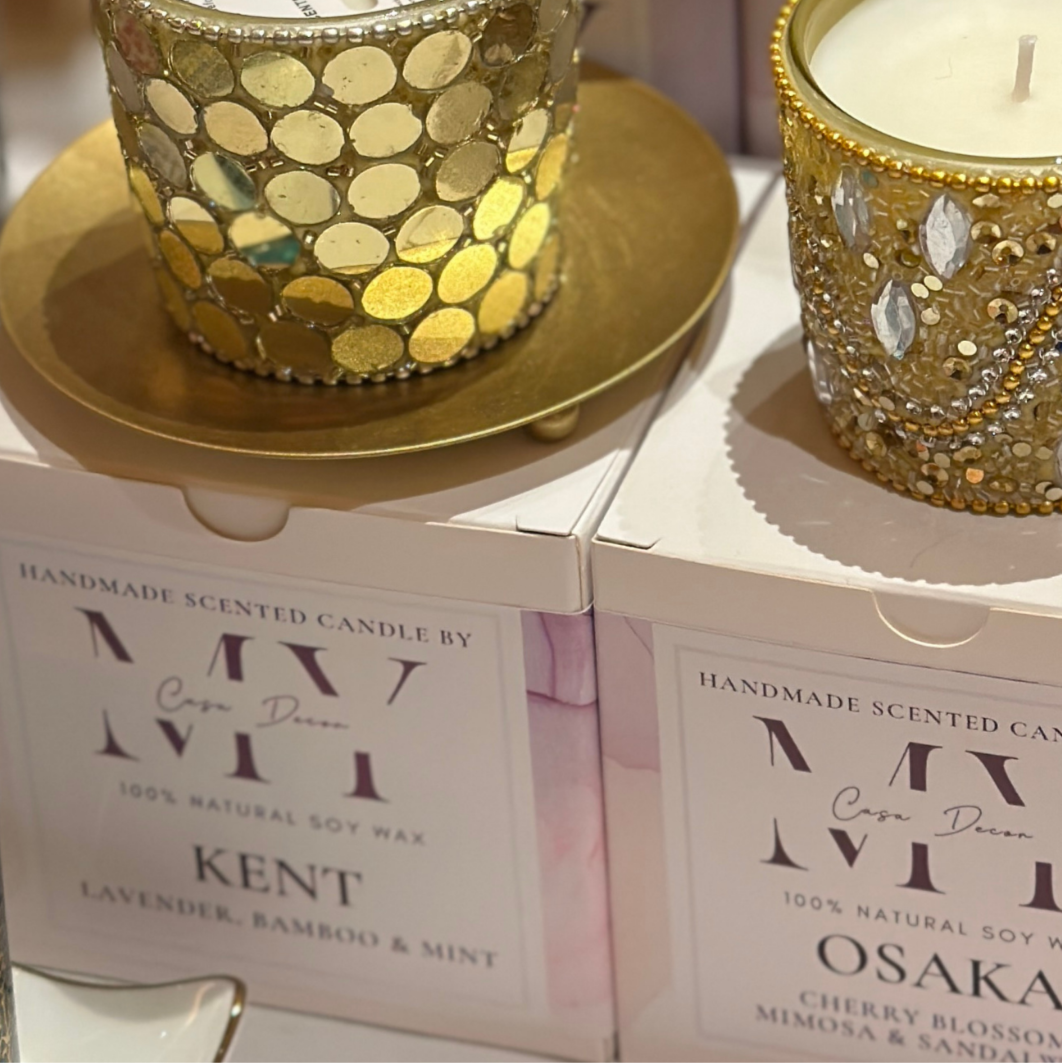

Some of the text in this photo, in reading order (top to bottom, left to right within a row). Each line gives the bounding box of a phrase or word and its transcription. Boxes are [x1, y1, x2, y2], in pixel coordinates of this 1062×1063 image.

[19, 563, 472, 648] HANDMADE SCENTED CANDLE BY
[156, 676, 232, 714] Casa
[700, 672, 861, 713] HANDMADE
[872, 700, 999, 733] SCENTED
[120, 782, 426, 846] 100% NATURAL SOY WAX
[831, 786, 1033, 840] Casa Decor
[193, 845, 362, 907] KENT
[252, 911, 379, 949] BAMBOO
[420, 940, 498, 969] MINT
[784, 891, 842, 913] 100%
[858, 905, 968, 937] NATURAL
[982, 926, 1034, 945] SOY
[755, 1004, 876, 1041] MIMOSA
[888, 1027, 907, 1046] &
[799, 991, 921, 1026] CHERRY
